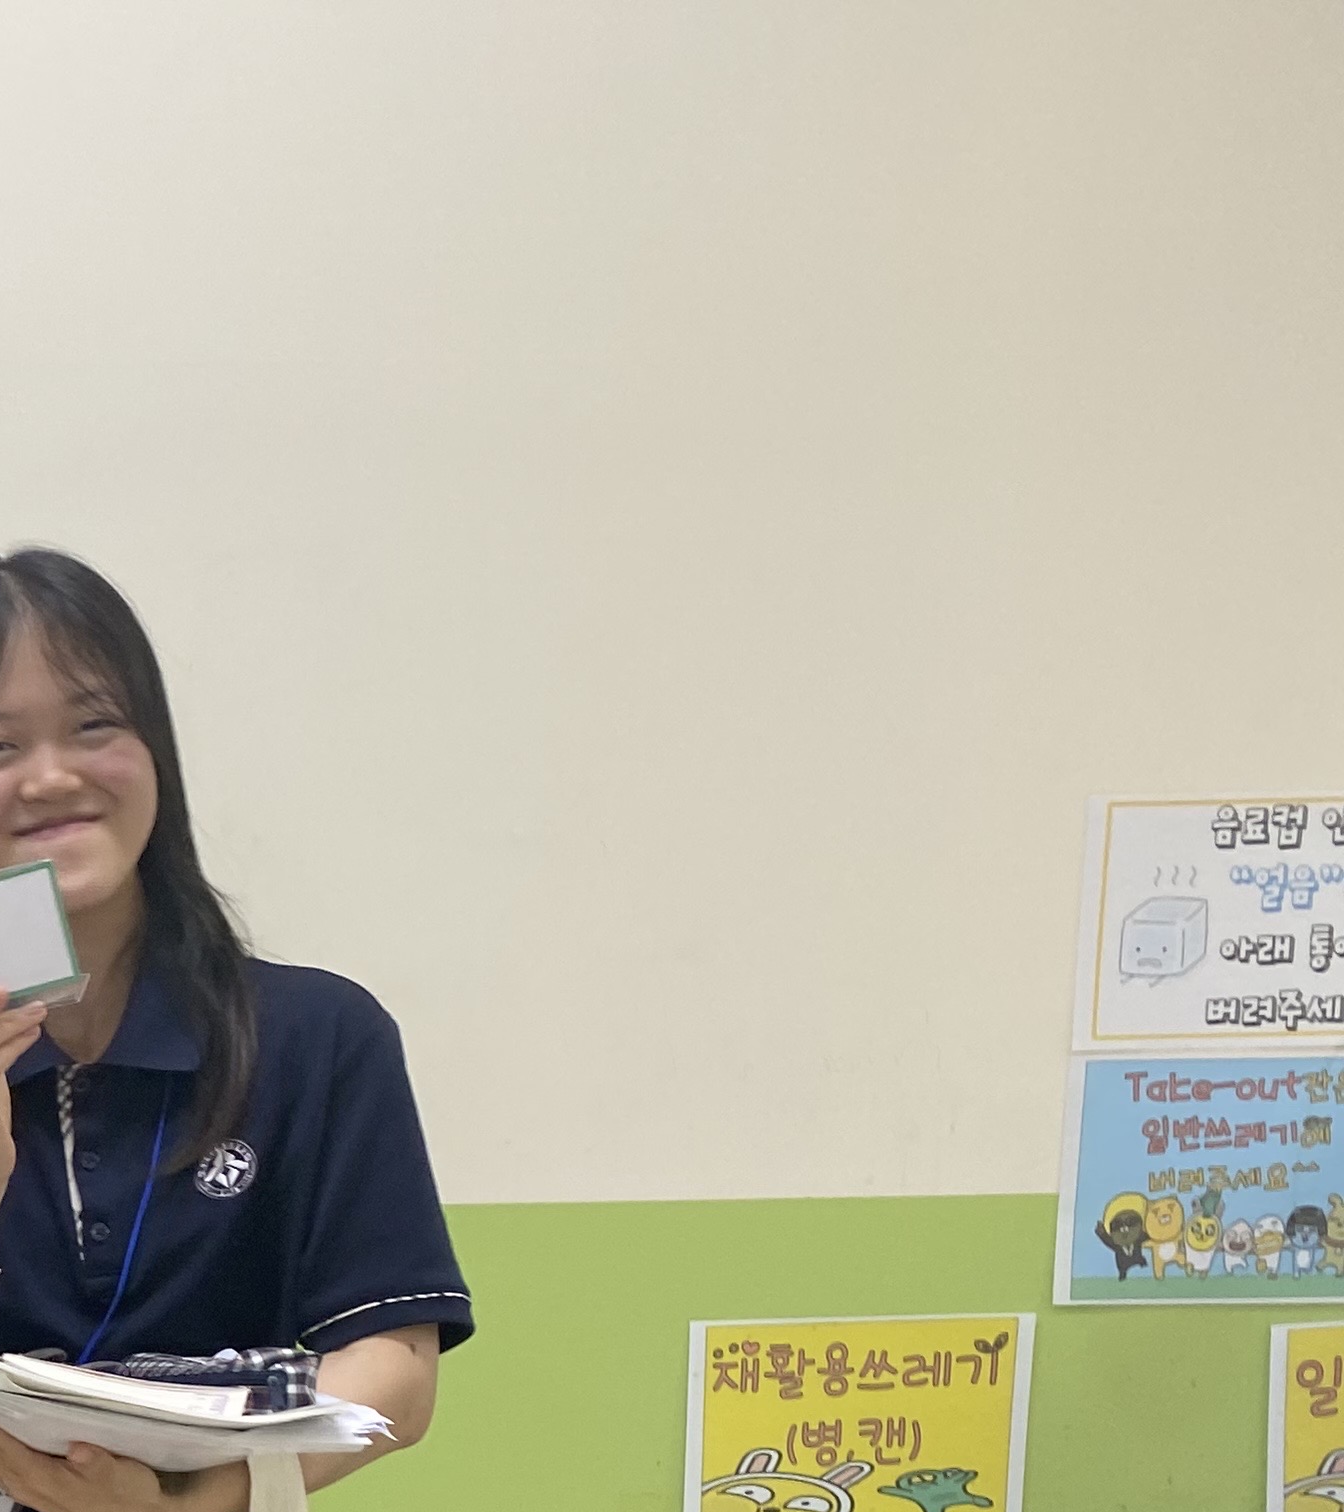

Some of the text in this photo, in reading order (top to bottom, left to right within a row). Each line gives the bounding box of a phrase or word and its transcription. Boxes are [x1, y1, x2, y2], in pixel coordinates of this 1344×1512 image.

[1212, 804, 1309, 850] 음료컵
[1219, 933, 1296, 965] 아래
[712, 1340, 1000, 1400] 재활용쓰레기
[786, 1416, 922, 1467] (병,캔)
